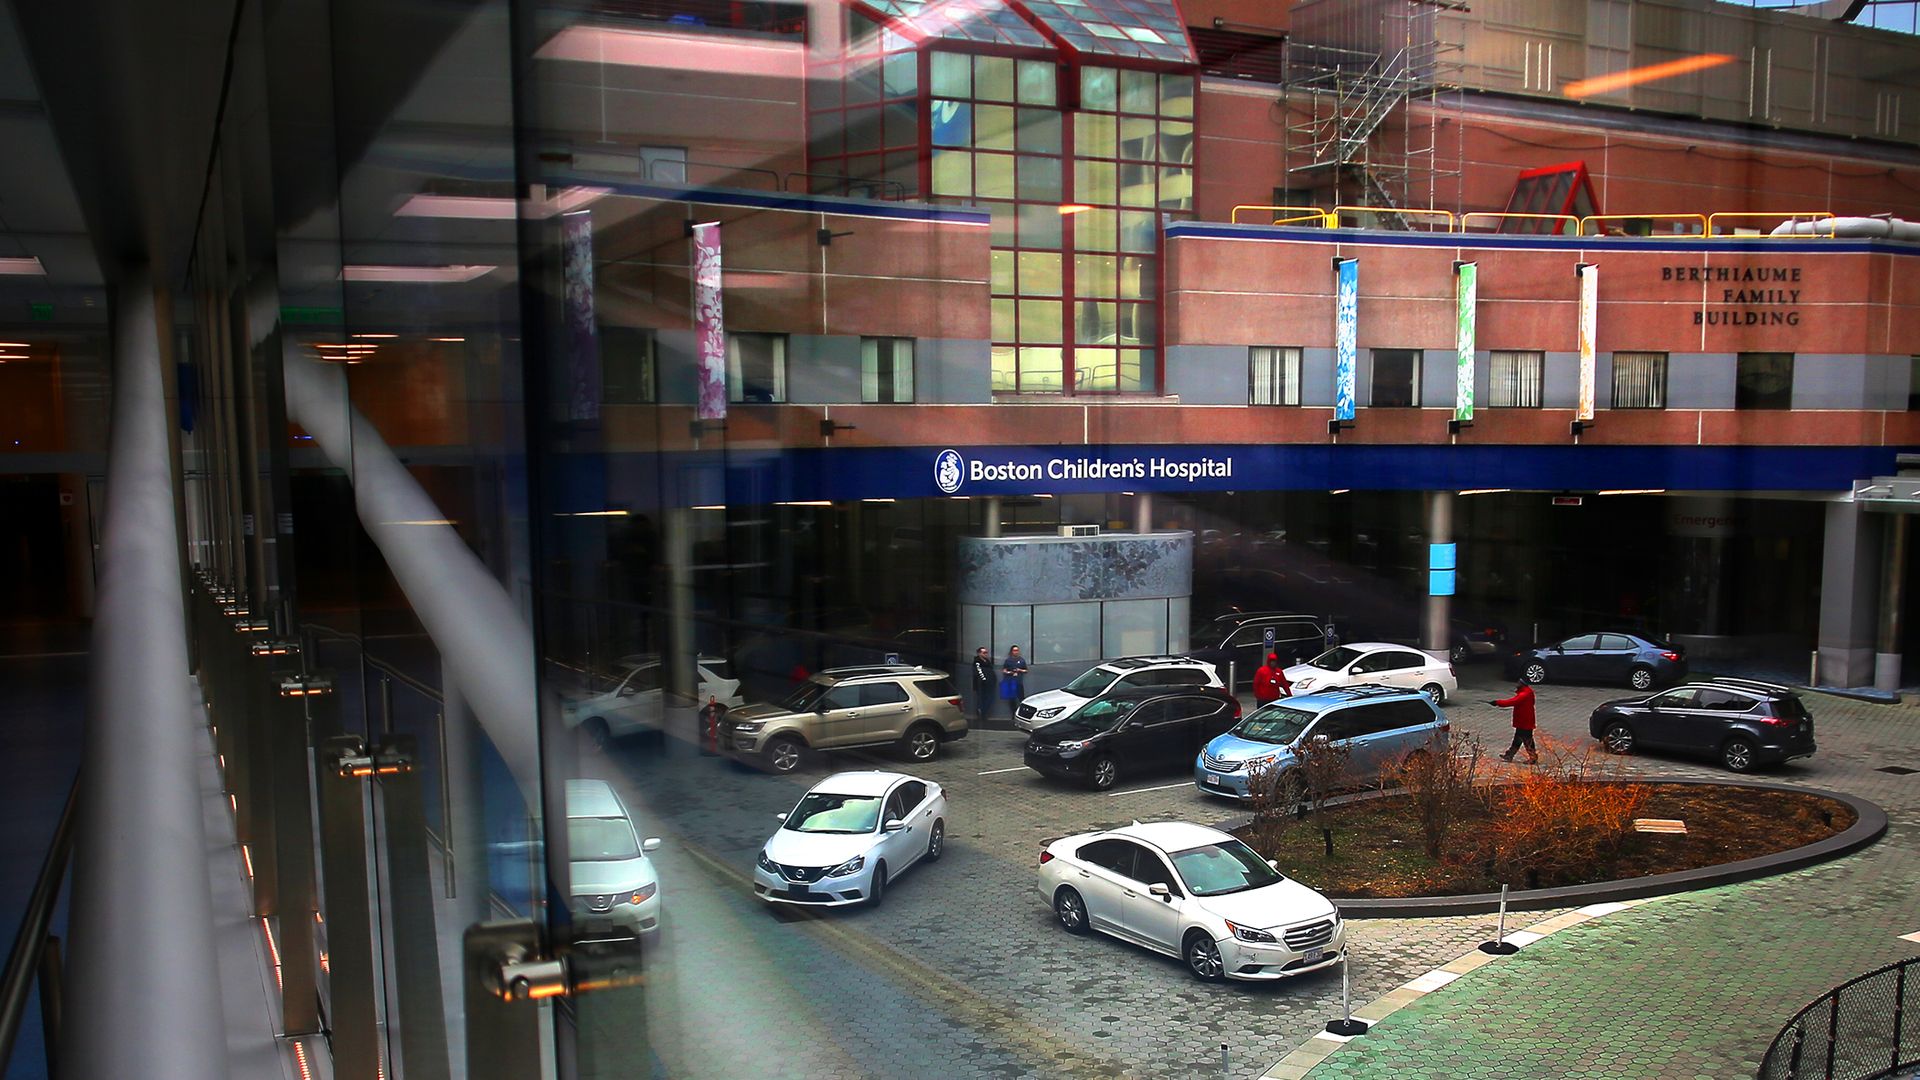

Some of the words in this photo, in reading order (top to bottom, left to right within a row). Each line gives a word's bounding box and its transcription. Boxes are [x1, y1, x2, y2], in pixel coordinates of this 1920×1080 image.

[1662, 267, 1801, 282] BERTHIAUME
[1723, 289, 1801, 303] FAMILY
[1693, 311, 1800, 326] BUILDING
[970, 460, 1042, 481] Boston
[1047, 457, 1145, 480] Children's
[1150, 457, 1232, 482] Hospital
[1672, 512, 1748, 528] Emergen
